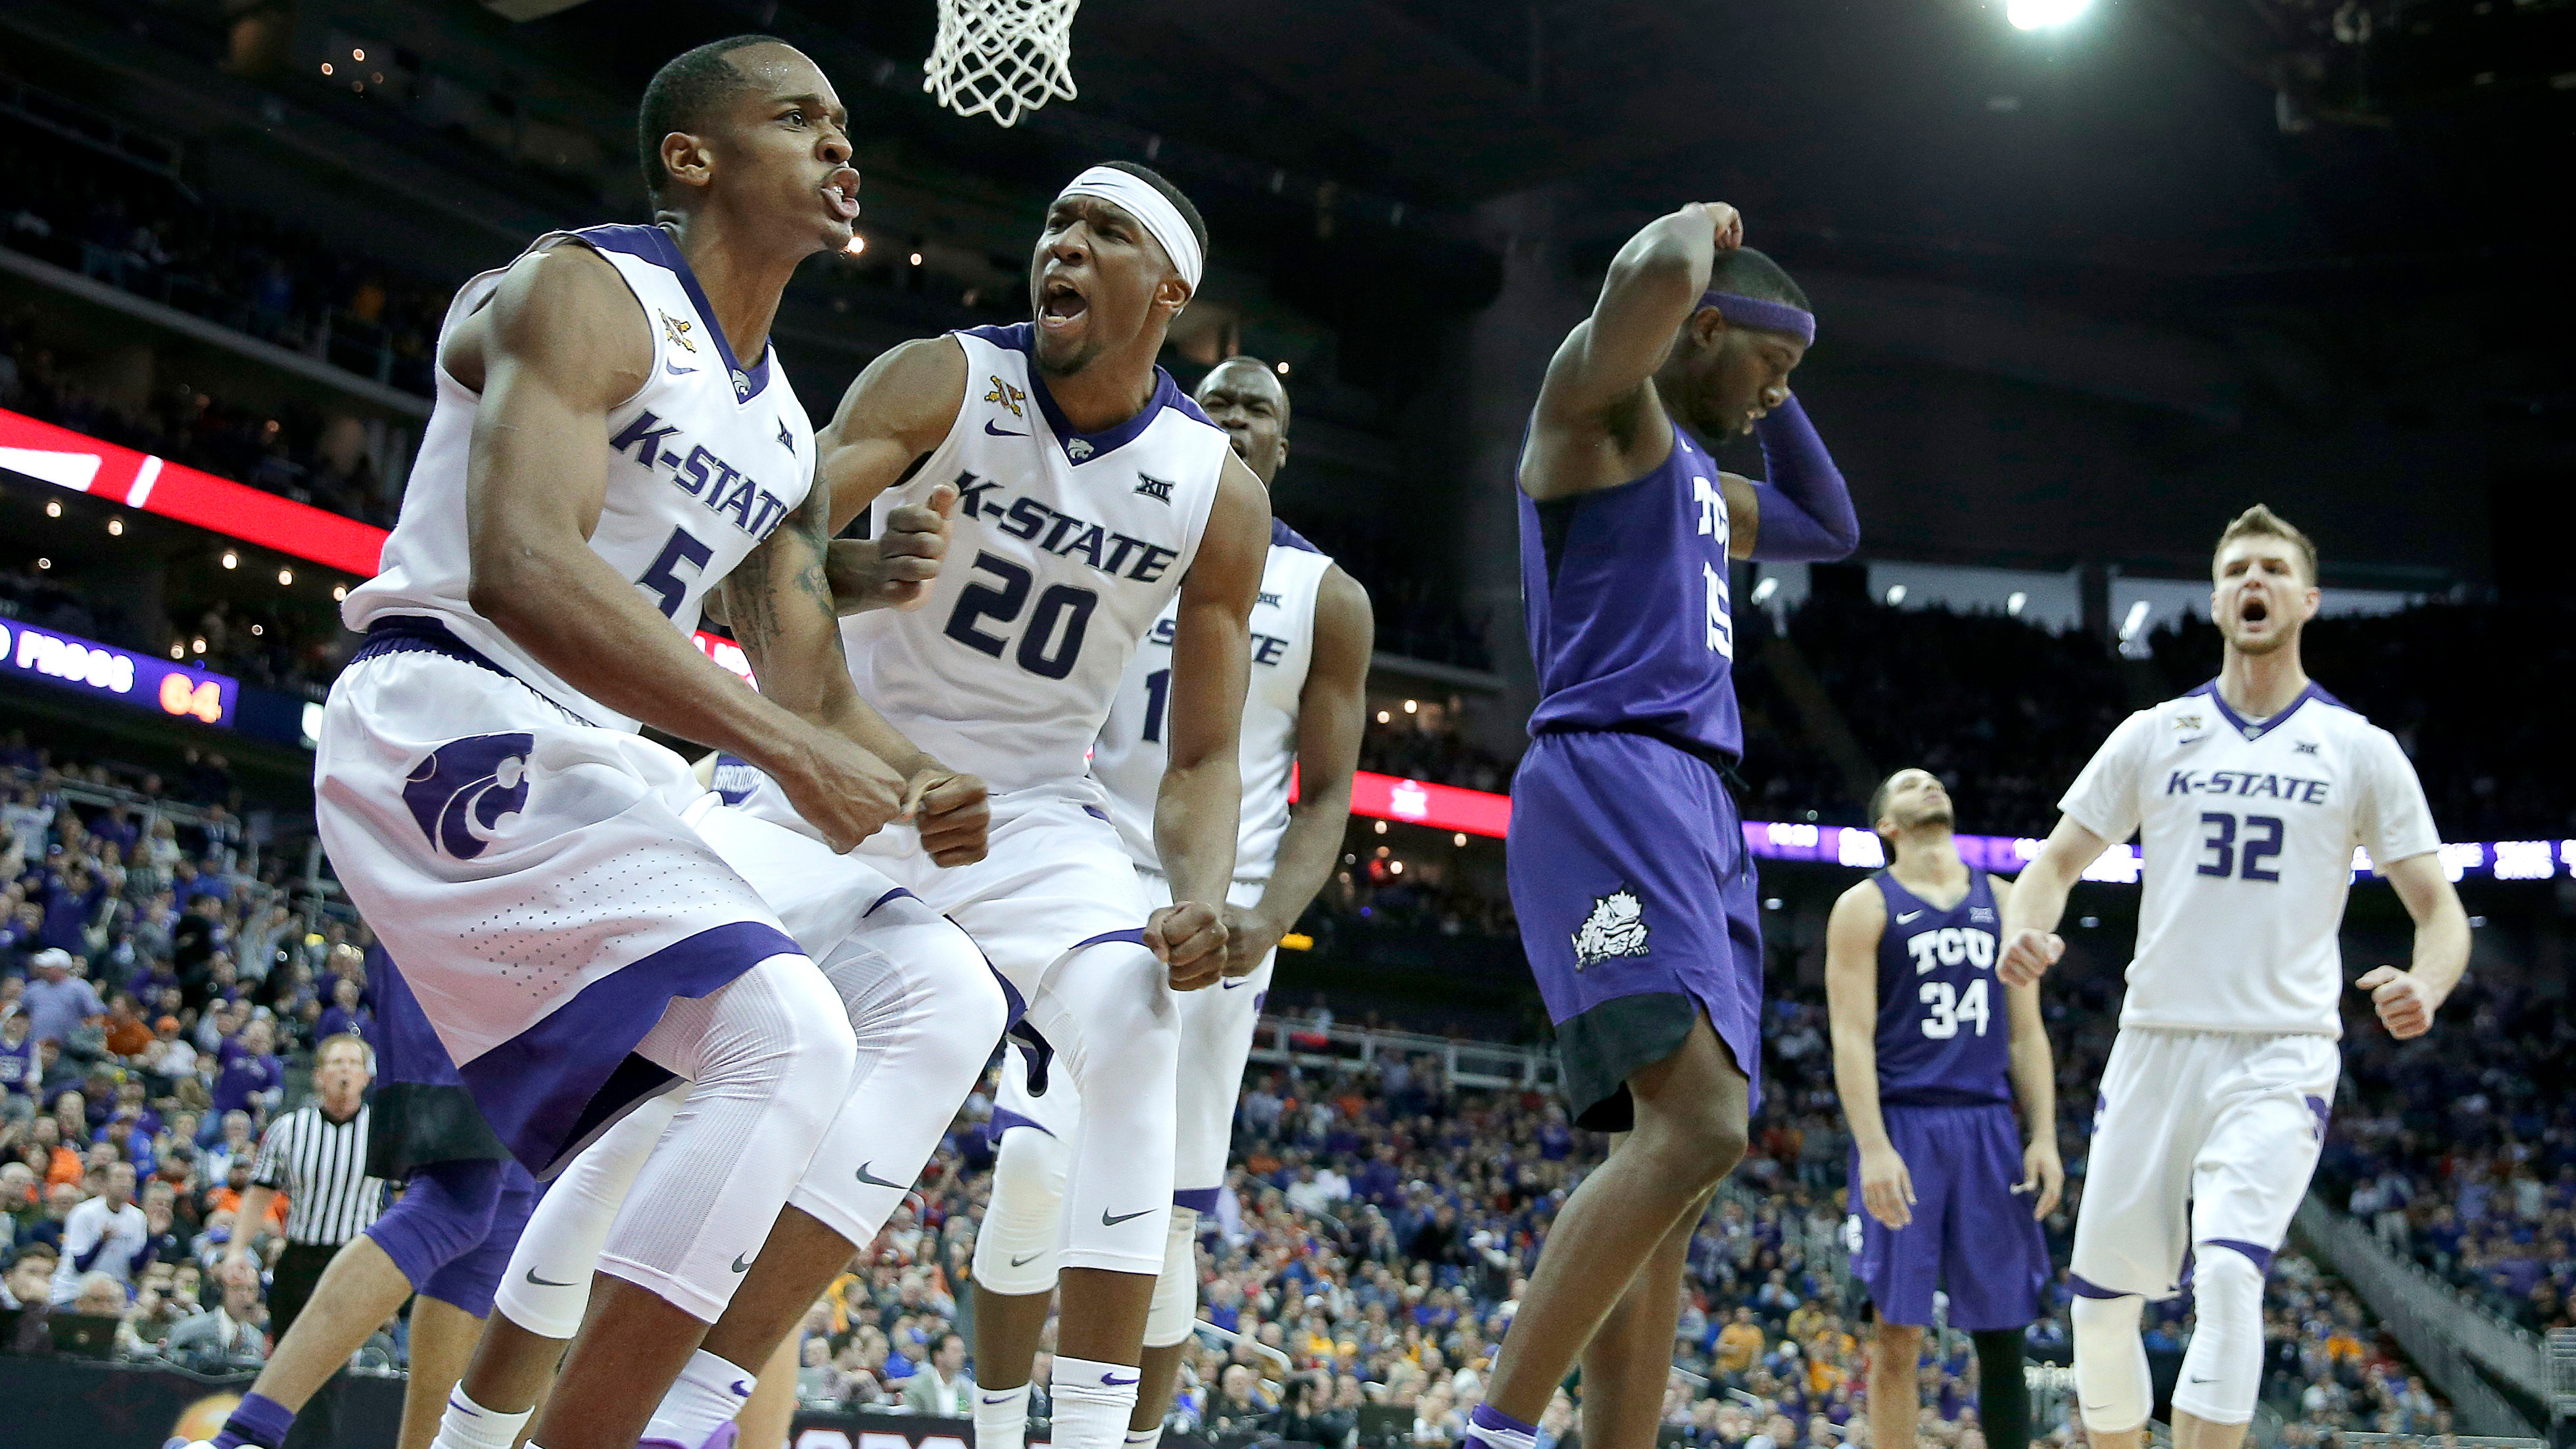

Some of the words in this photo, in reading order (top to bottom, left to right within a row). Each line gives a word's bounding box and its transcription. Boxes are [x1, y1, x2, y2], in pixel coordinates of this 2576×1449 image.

[954, 470, 1179, 583] K-STATE
[1693, 476, 1730, 567] TC
[634, 524, 715, 619] 5
[1703, 561, 1733, 662] 15
[944, 549, 1098, 680] 20
[159, 672, 222, 723] 64
[2167, 769, 2329, 806] K-STATE
[2197, 812, 2285, 882] 32
[1907, 927, 1995, 976] TCU
[1919, 978, 1991, 1040] 34
